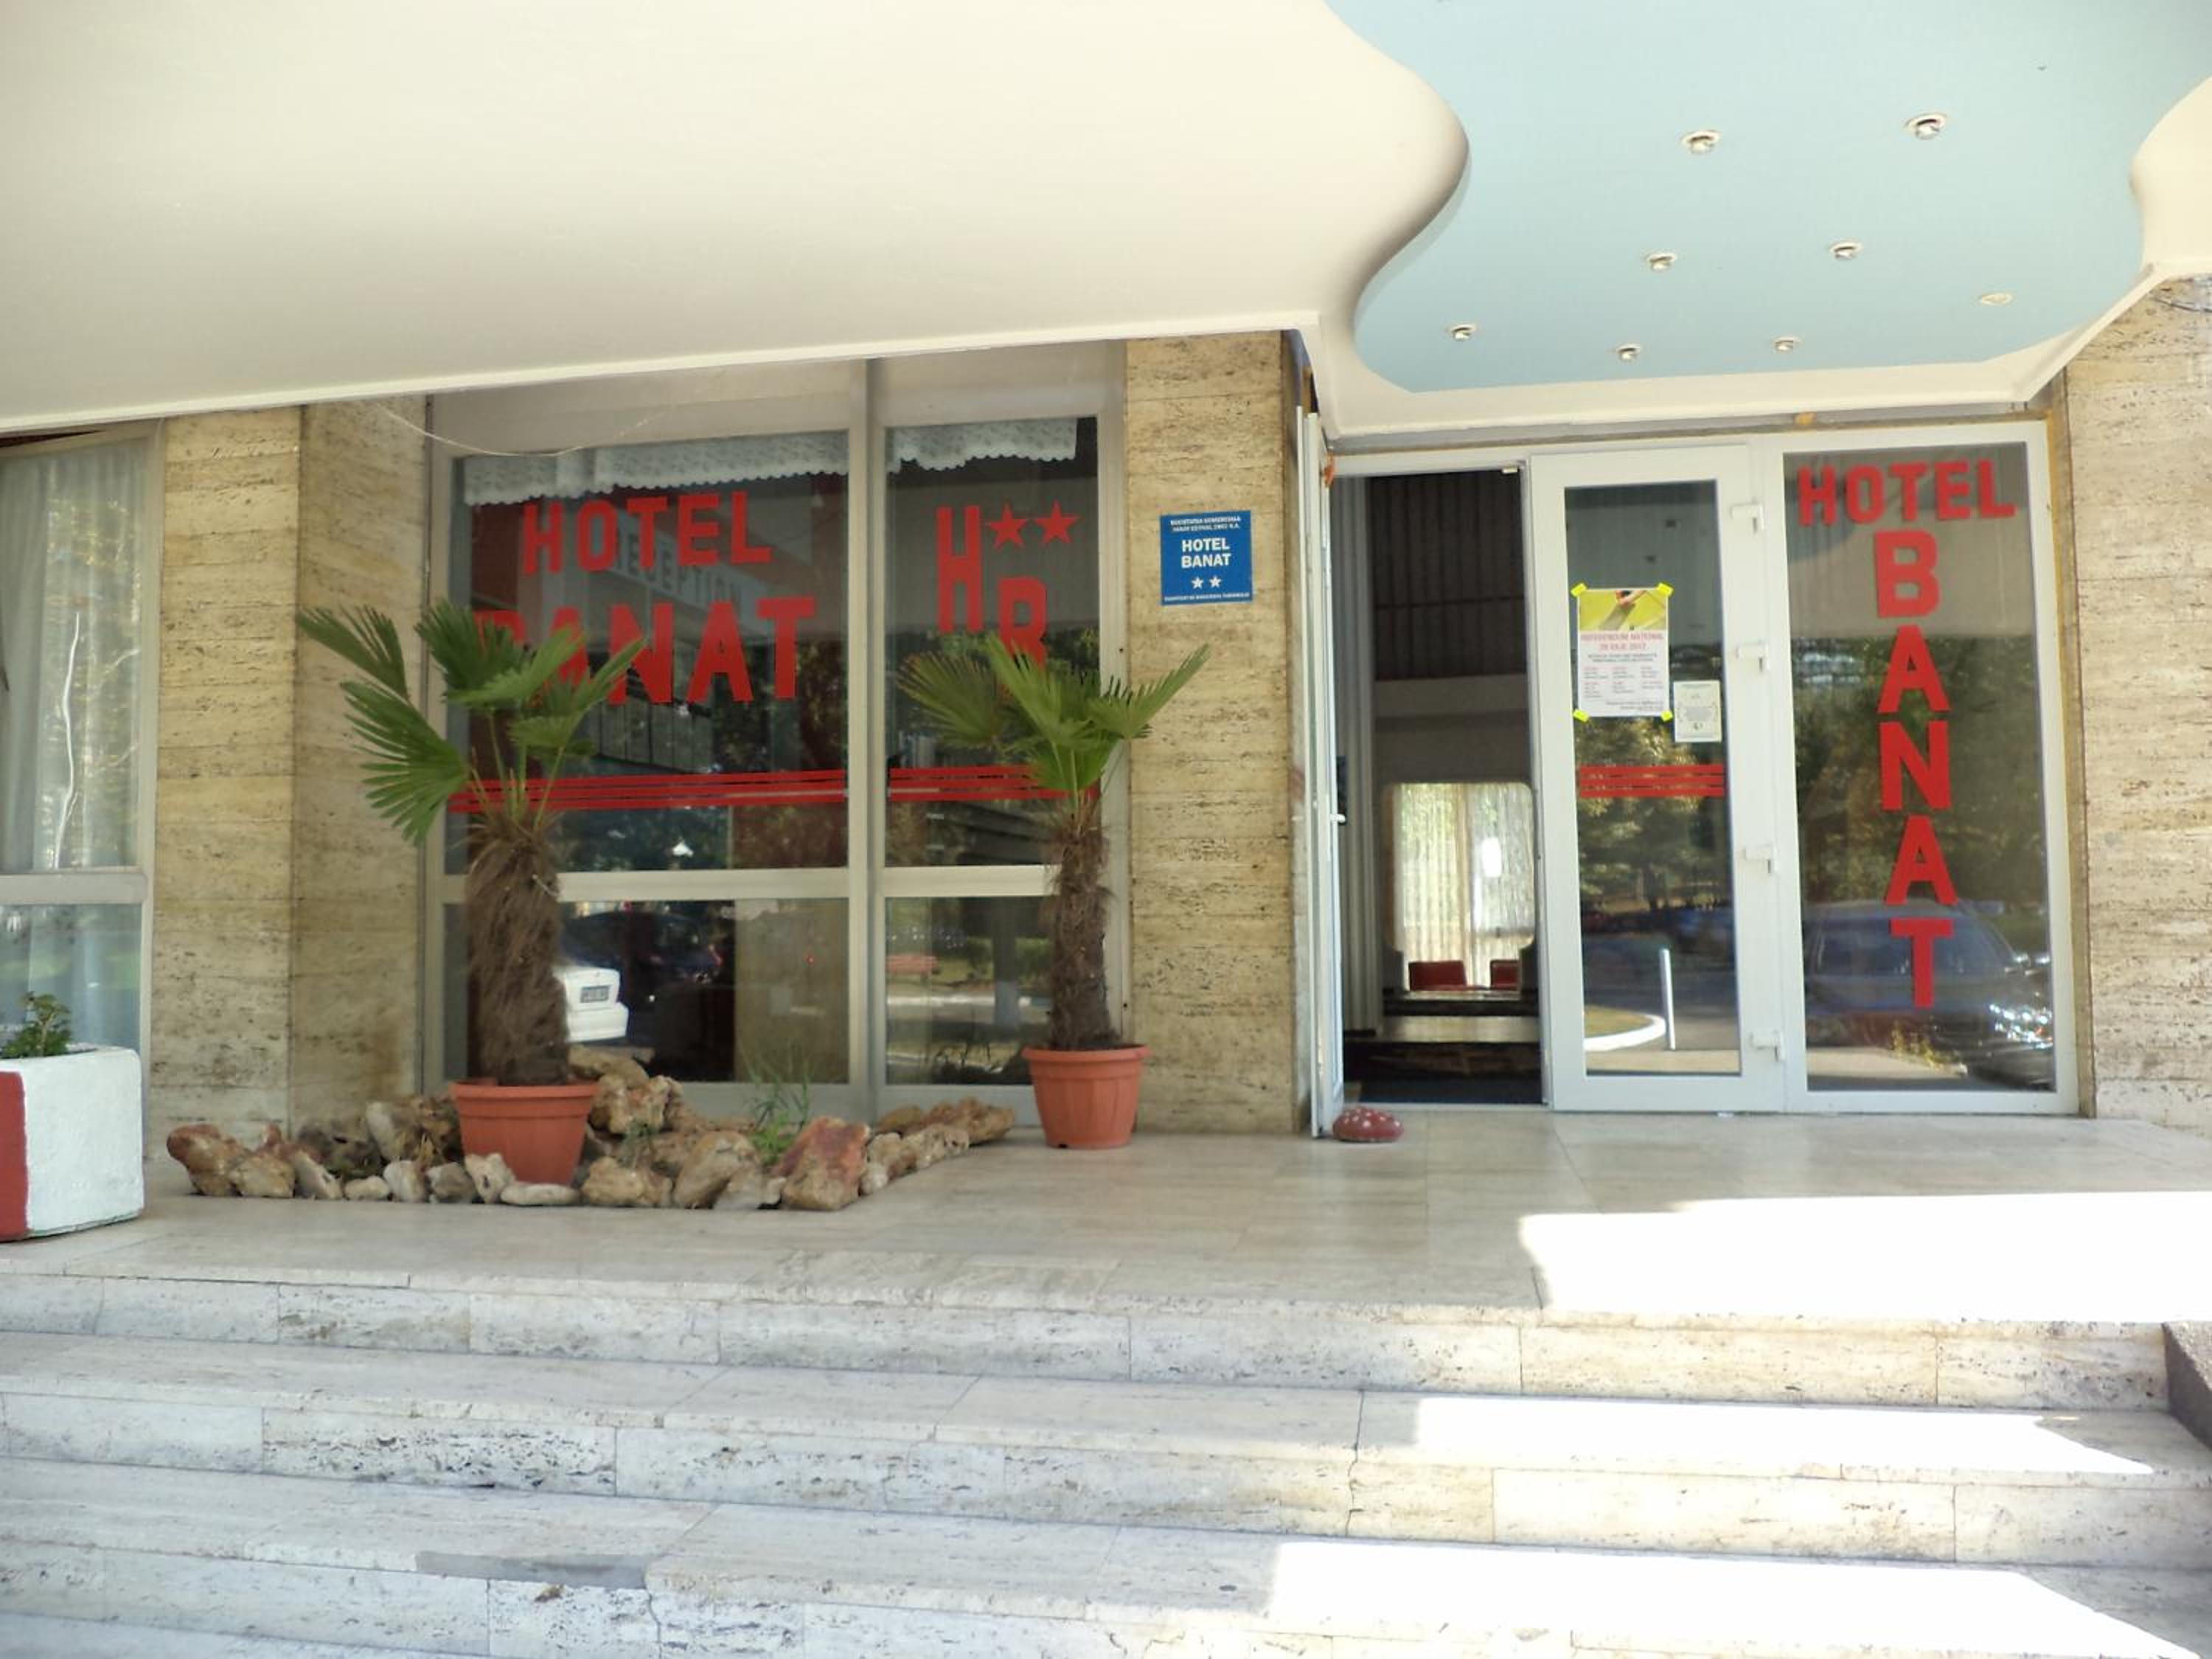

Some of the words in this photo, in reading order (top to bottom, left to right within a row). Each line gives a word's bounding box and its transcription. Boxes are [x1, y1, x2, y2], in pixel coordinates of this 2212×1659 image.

[1797, 459, 2017, 526] HOTEL
[522, 491, 773, 576] HOTEL
[1180, 553, 1231, 568] BANAT
[1181, 538, 1231, 552] HOTEL
[1874, 527, 1959, 1009] BANAT
